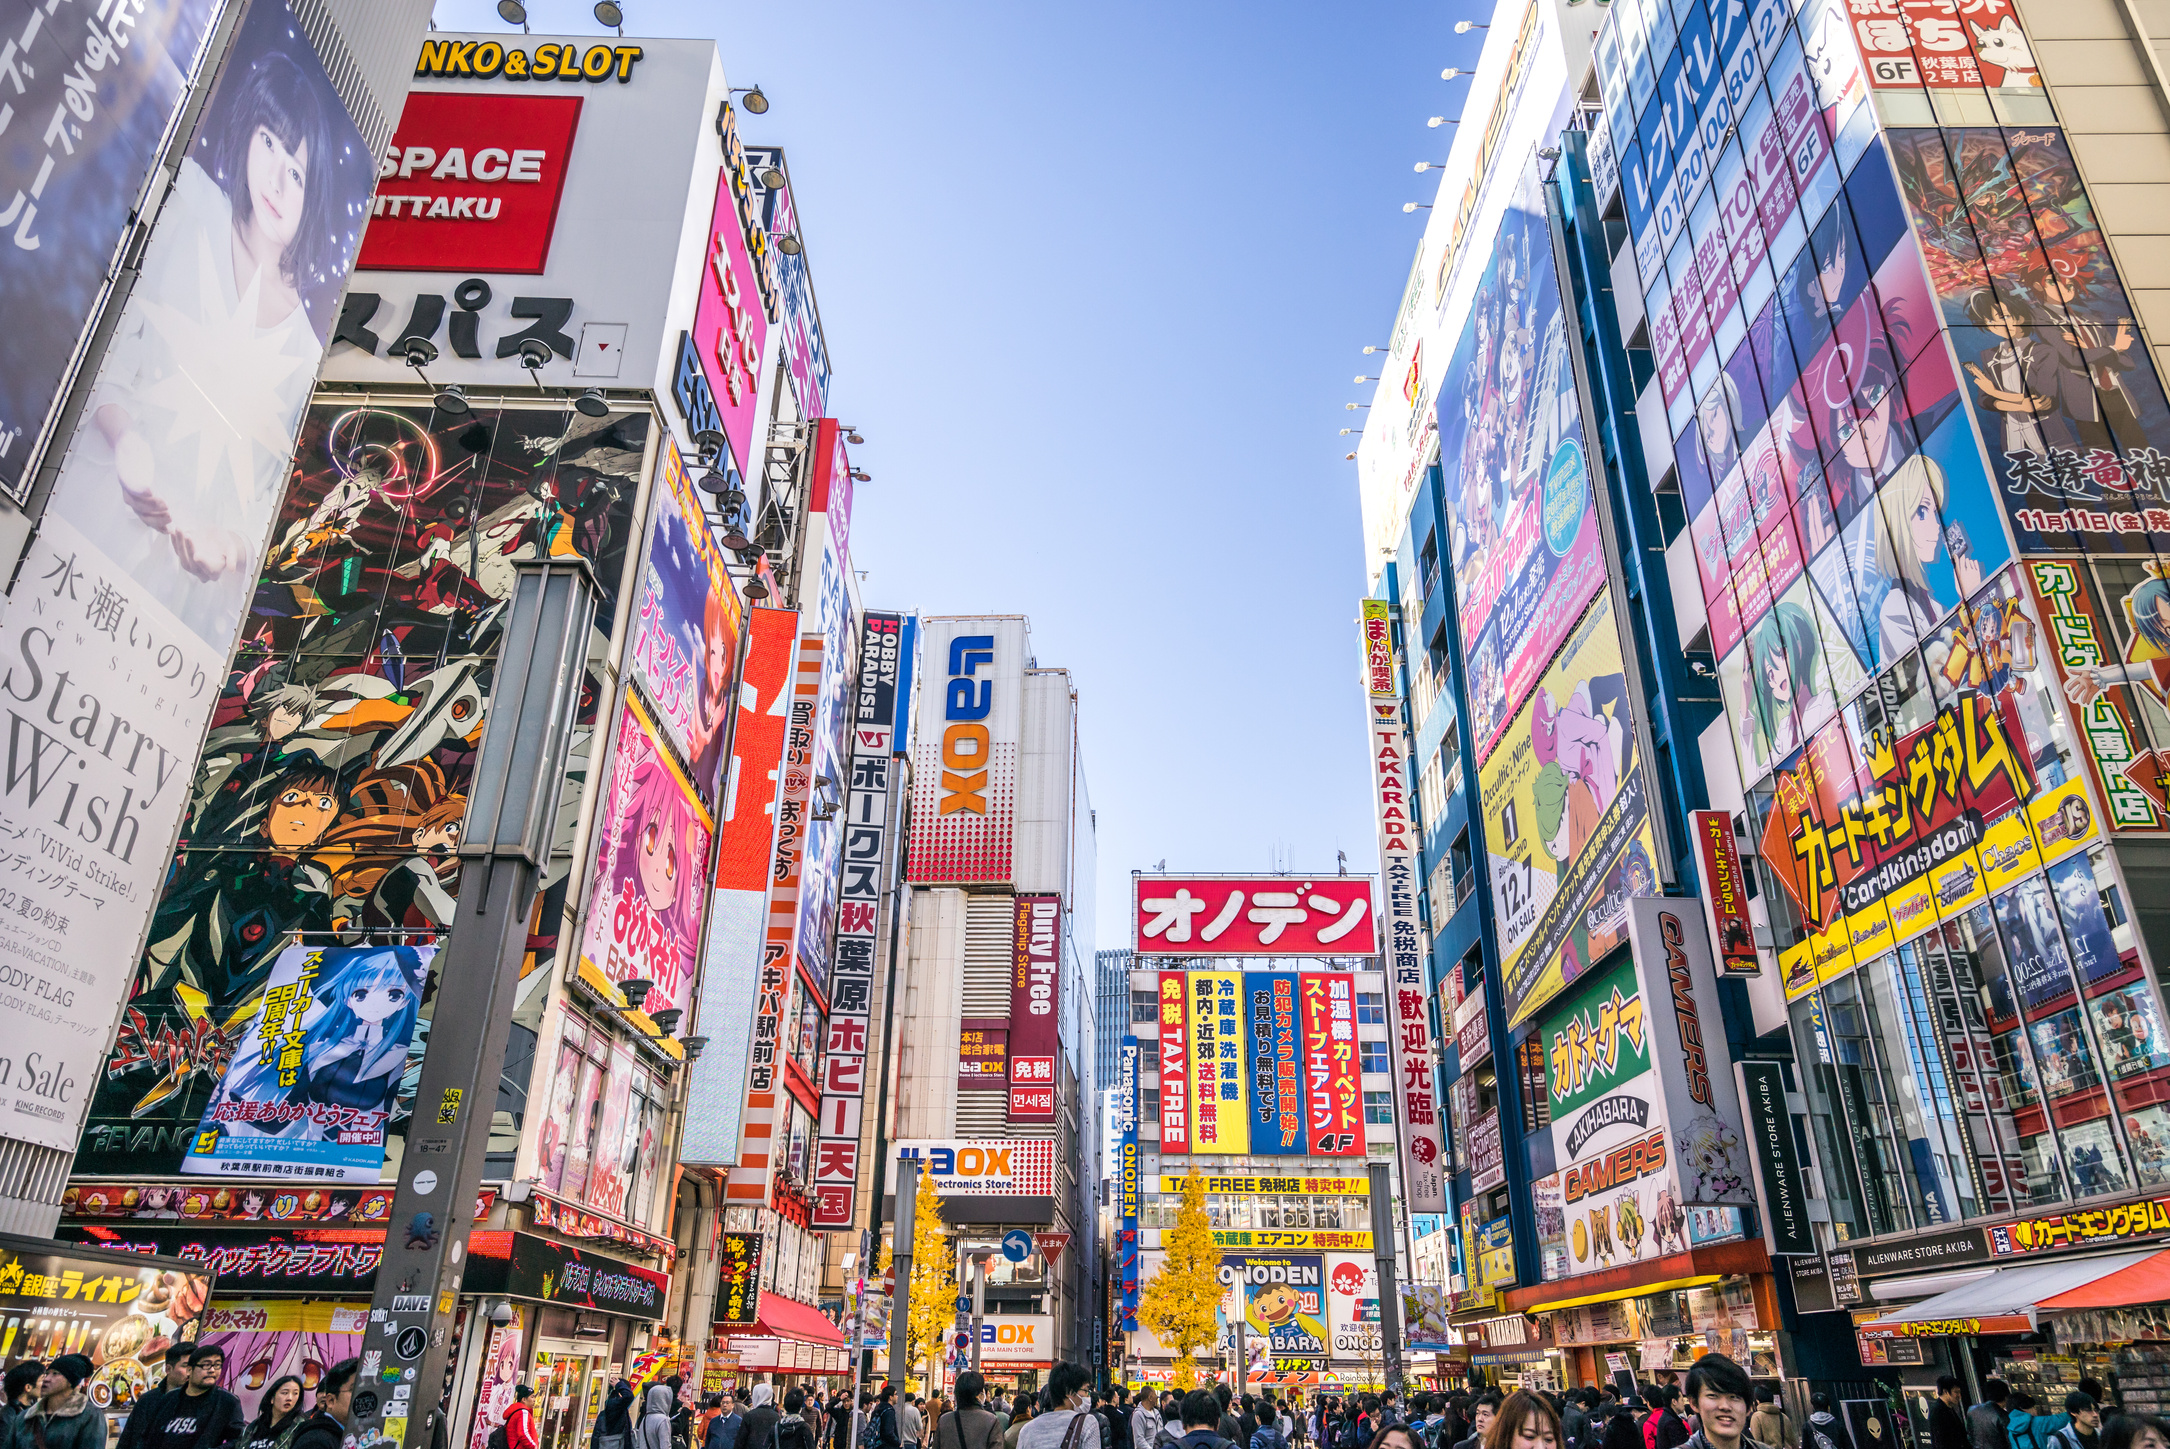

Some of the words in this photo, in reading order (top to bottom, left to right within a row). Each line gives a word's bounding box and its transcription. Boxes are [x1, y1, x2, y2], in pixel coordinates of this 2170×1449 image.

[1855, 13, 1969, 53] ぽち
[1874, 61, 1913, 81] 6F
[1920, 55, 1979, 71] 秋葉原
[1924, 69, 1983, 84] 2号店
[1796, 131, 1822, 179] 6F
[371, 194, 502, 220] ITTAKU
[710, 232, 760, 394] エスパス
[40, 551, 207, 699] 水瀬いのり
[32, 596, 86, 646] New
[108, 654, 191, 728] Single
[858, 618, 883, 721] PARADISE
[880, 619, 899, 688] HOBBY
[1366, 617, 1394, 693] まんが喫茶
[1, 626, 183, 810] Starry
[6, 708, 139, 866] Wish
[1376, 731, 1409, 851] TAKARADA
[1793, 690, 2040, 927] カードキングダム
[1709, 827, 1738, 915] カードキングダム
[1845, 816, 1978, 911] cardkingdom
[1981, 833, 2034, 873] Chaos
[1500, 853, 1533, 923] 12.7
[1015, 901, 1031, 952] Flagship
[1028, 901, 1059, 957] Duty
[1141, 881, 1368, 945] オノデン
[1507, 922, 1520, 944] ON
[1516, 911, 1537, 938] SALE
[1016, 954, 1030, 989] Store
[1391, 920, 1421, 985] 免税商店
[34, 978, 76, 1009] FLAG
[1029, 960, 1058, 1016] Free
[1161, 978, 1184, 1026] 免税
[277, 950, 324, 1088] スニーカー文庫は
[1658, 910, 1717, 1115] GAMERS
[960, 1031, 984, 1043] 本店
[960, 1043, 1005, 1056] 総合家電
[1162, 1028, 1184, 1076] TAX
[1253, 990, 1275, 1123] お見積り無料です
[17, 1050, 76, 1103] Sale
[1014, 1061, 1051, 1079] 免税
[1273, 979, 1299, 1147] 防犯カメラ販売開始!!
[1012, 1093, 1051, 1108] 면세점
[1122, 1045, 1138, 1133] Panasonic
[1758, 1075, 1776, 1114] AKIBA
[210, 1099, 391, 1130] 応援ありがとうフェア
[1163, 1080, 1186, 1143] FREE
[1571, 1097, 1642, 1152] AKIHABARA
[339, 1130, 381, 1145] 開催中!!
[1316, 1133, 1355, 1152] 4F
[1767, 1118, 1782, 1159] STORE
[219, 1161, 347, 1179] 秋葉原駅前商店街振興組合
[985, 1178, 1013, 1189] Store
[1123, 1142, 1138, 1218] ONODEN
[1208, 1178, 1256, 1193] FREE
[1258, 1178, 1300, 1193] 免税店
[1414, 1180, 1423, 1199] Shop
[1421, 1170, 1431, 1199] Tax-free
[1565, 1132, 1667, 1206] GAMERS
[1776, 1164, 1798, 1240] ALIENWARE
[1041, 1239, 1063, 1248] 止まれ
[1211, 1231, 1252, 1247] 冷蔵庫
[1257, 1232, 1309, 1246] エアコン
[1312, 1232, 1367, 1248] 特売中!!
[2033, 1200, 2170, 1247] カードキングダム
[1245, 1258, 1282, 1267] Welcome
[1282, 1258, 1292, 1266] to
[1794, 1256, 1822, 1268] ALIENWARE
[1795, 1268, 1811, 1278] STORE
[1810, 1267, 1824, 1276] AKIBA
[1867, 1249, 1914, 1266] ALIENWARE
[1915, 1244, 1945, 1259] STORE
[1946, 1240, 1975, 1254] AKIBA
[20, 1269, 144, 1304] 銀座ライオン
[1218, 1265, 1320, 1285] ONODEN
[393, 1295, 431, 1312] DAVE
[1909, 1318, 1970, 1337] カードキングダム
[1013, 1346, 1035, 1354] STORE
